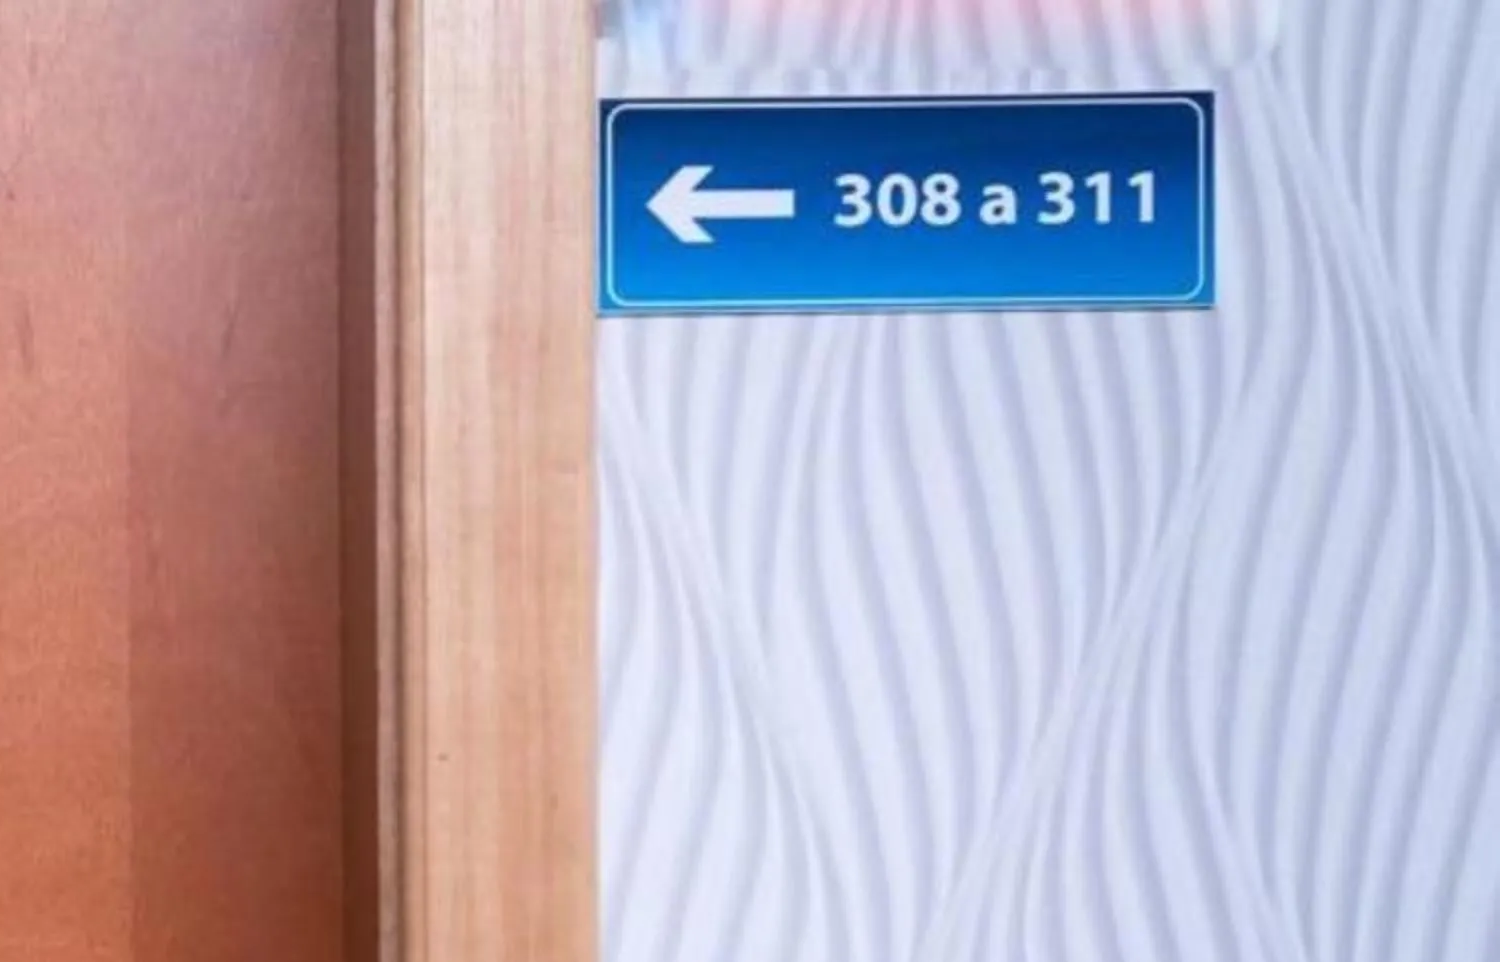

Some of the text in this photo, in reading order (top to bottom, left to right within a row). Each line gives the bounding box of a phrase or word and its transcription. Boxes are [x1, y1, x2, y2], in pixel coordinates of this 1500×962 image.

[833, 170, 1156, 228] 308 a 311
